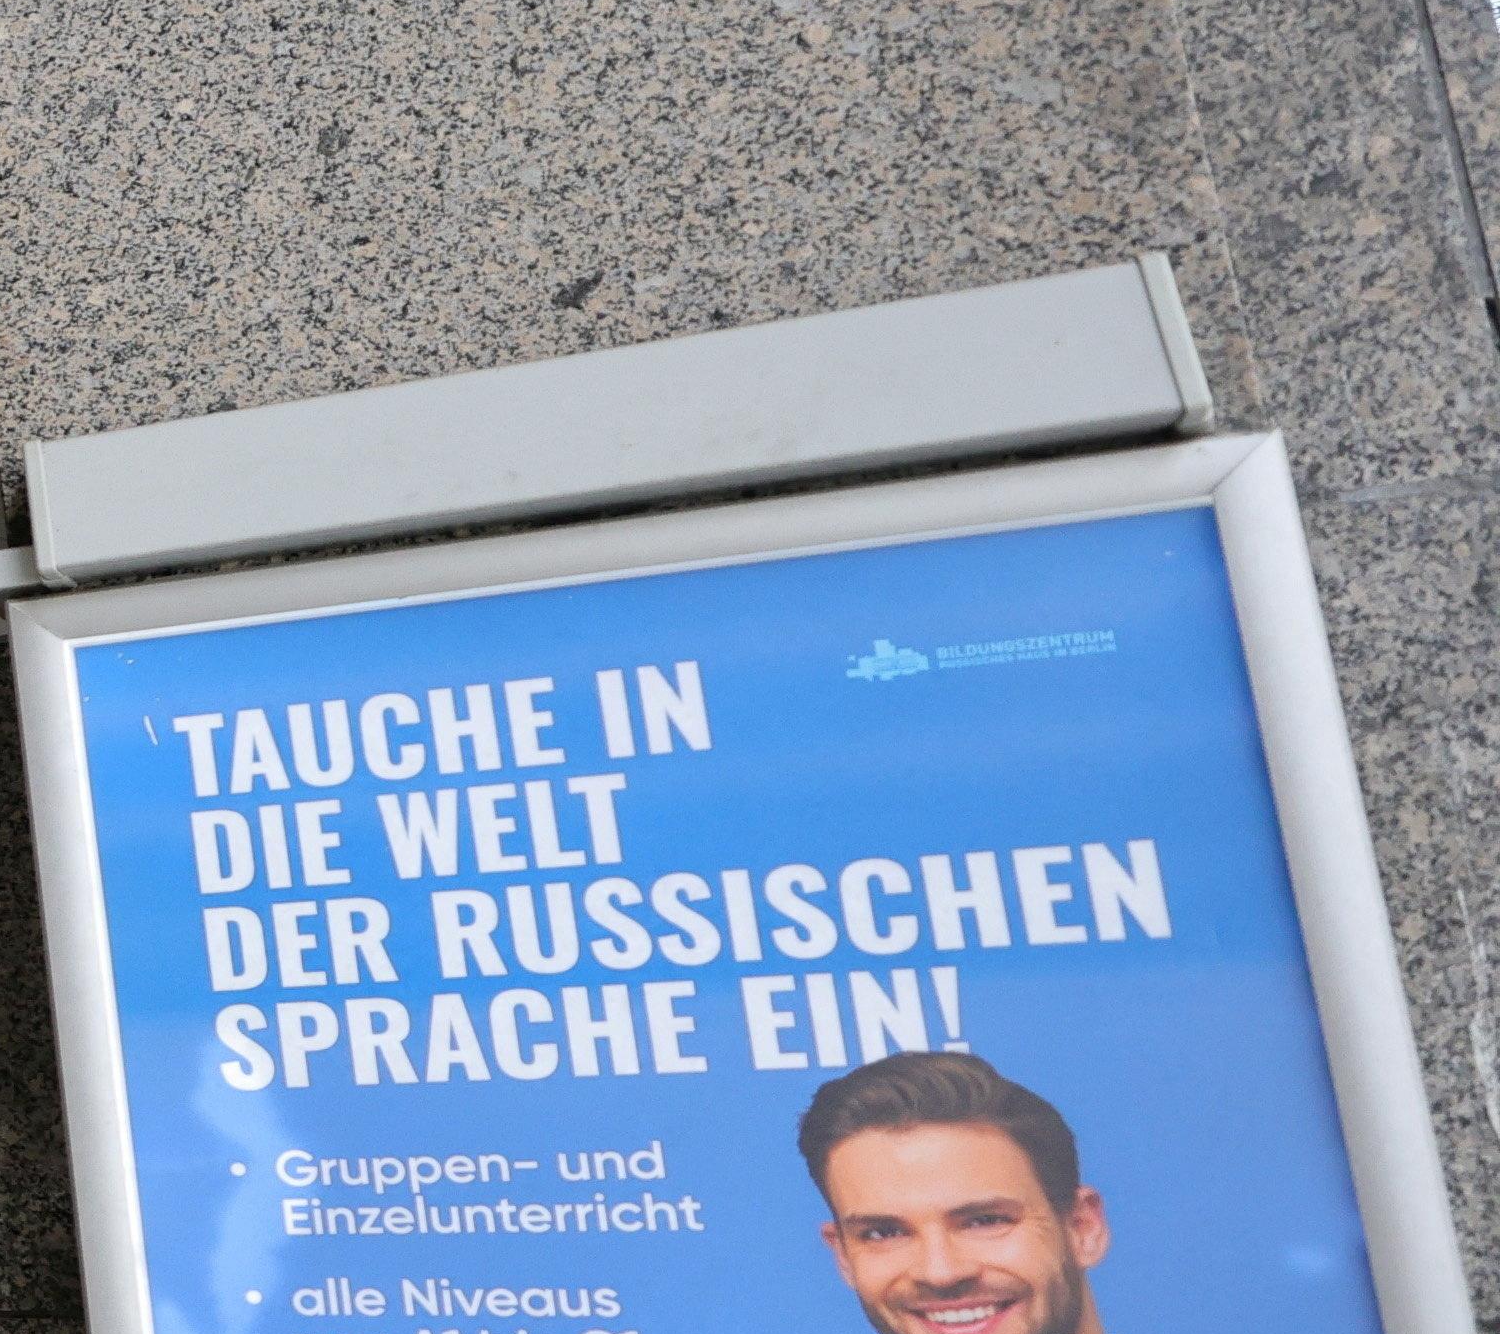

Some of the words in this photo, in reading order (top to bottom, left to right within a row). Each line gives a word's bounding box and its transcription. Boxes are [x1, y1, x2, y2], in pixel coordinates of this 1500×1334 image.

[172, 676, 566, 798] TAUCHE
[597, 661, 711, 757] IN
[190, 807, 350, 895] DIE
[378, 773, 628, 880] WELT
[202, 903, 400, 993] DER
[432, 838, 1173, 977] RUSSISCHEN
[214, 980, 709, 1092] SPRACHE
[740, 967, 971, 1073] EIN!
[274, 1146, 540, 1195] Gruppen-
[557, 1139, 666, 1183] und
[282, 1192, 703, 1237] Einzelunterricht
[291, 1277, 388, 1318] alle
[402, 1279, 621, 1320] Niveaus
